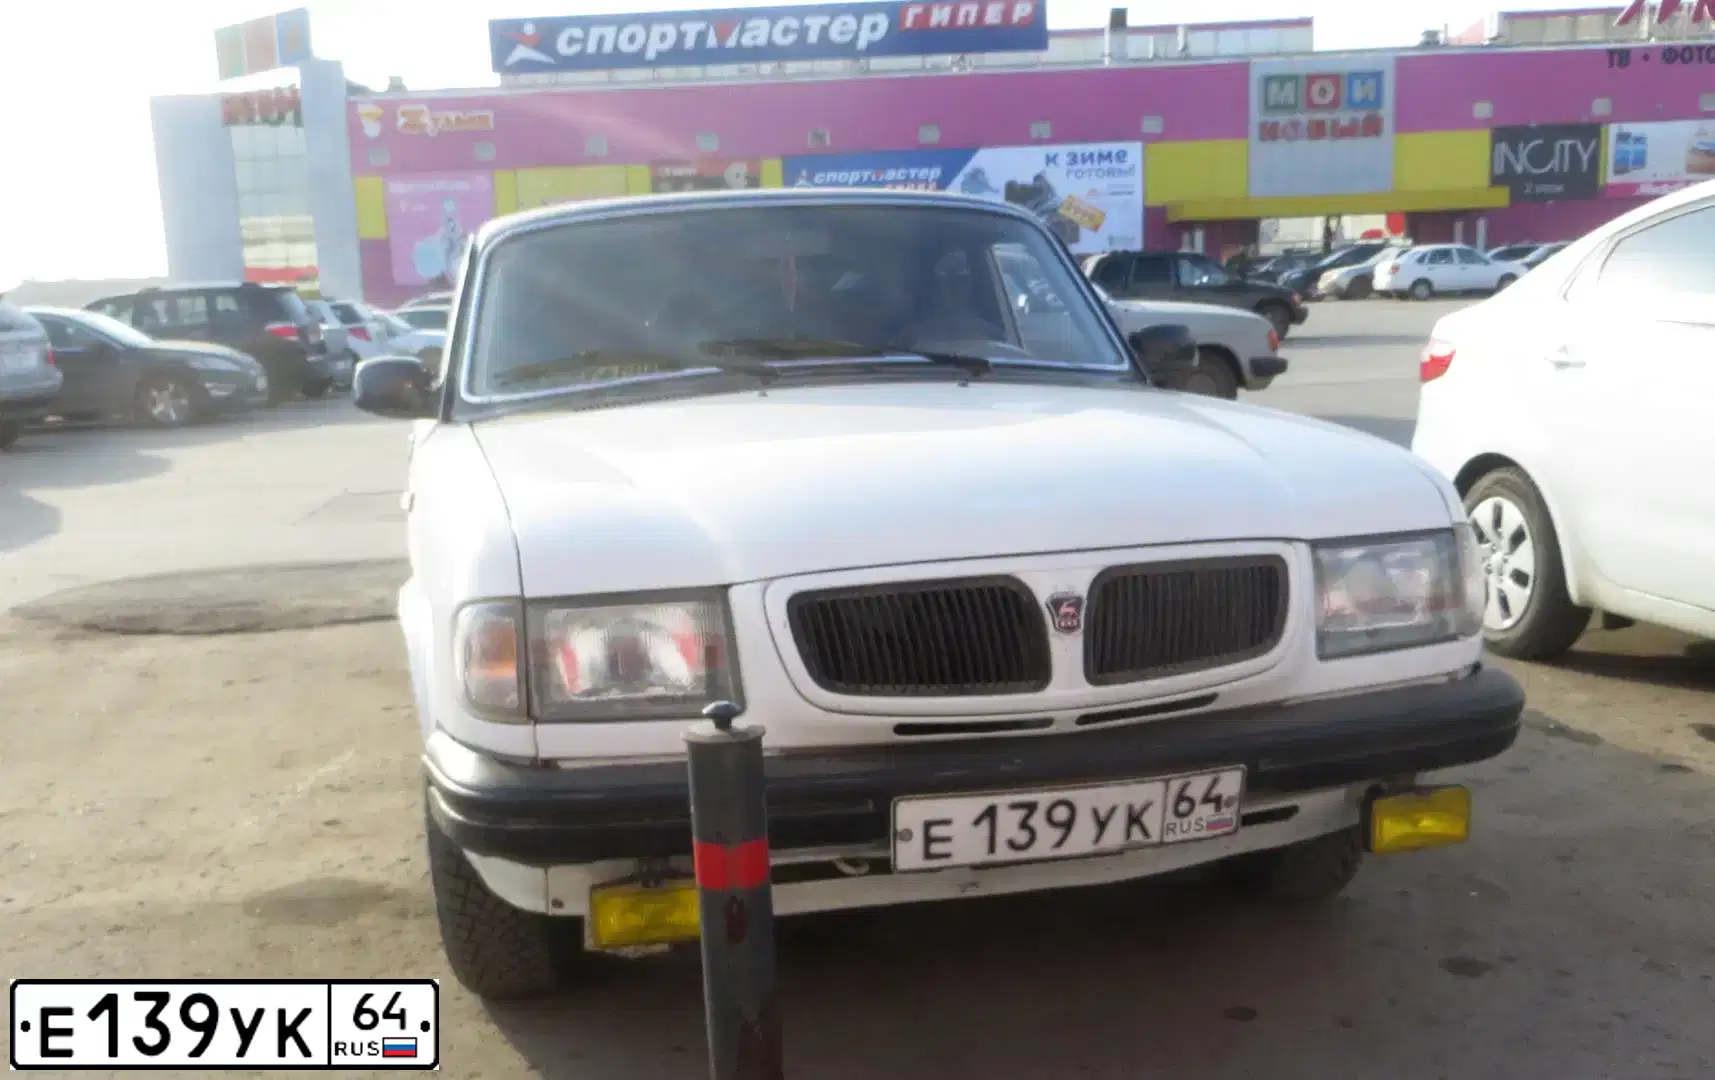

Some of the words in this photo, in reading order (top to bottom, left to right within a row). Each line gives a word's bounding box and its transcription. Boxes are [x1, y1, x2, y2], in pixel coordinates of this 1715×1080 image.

[905, 1, 1034, 28] ГИПЕР
[1265, 75, 1381, 107] МОЙ
[1493, 139, 1597, 175] INCITY
[1171, 775, 1223, 820] 64
[1165, 816, 1205, 837] RUS
